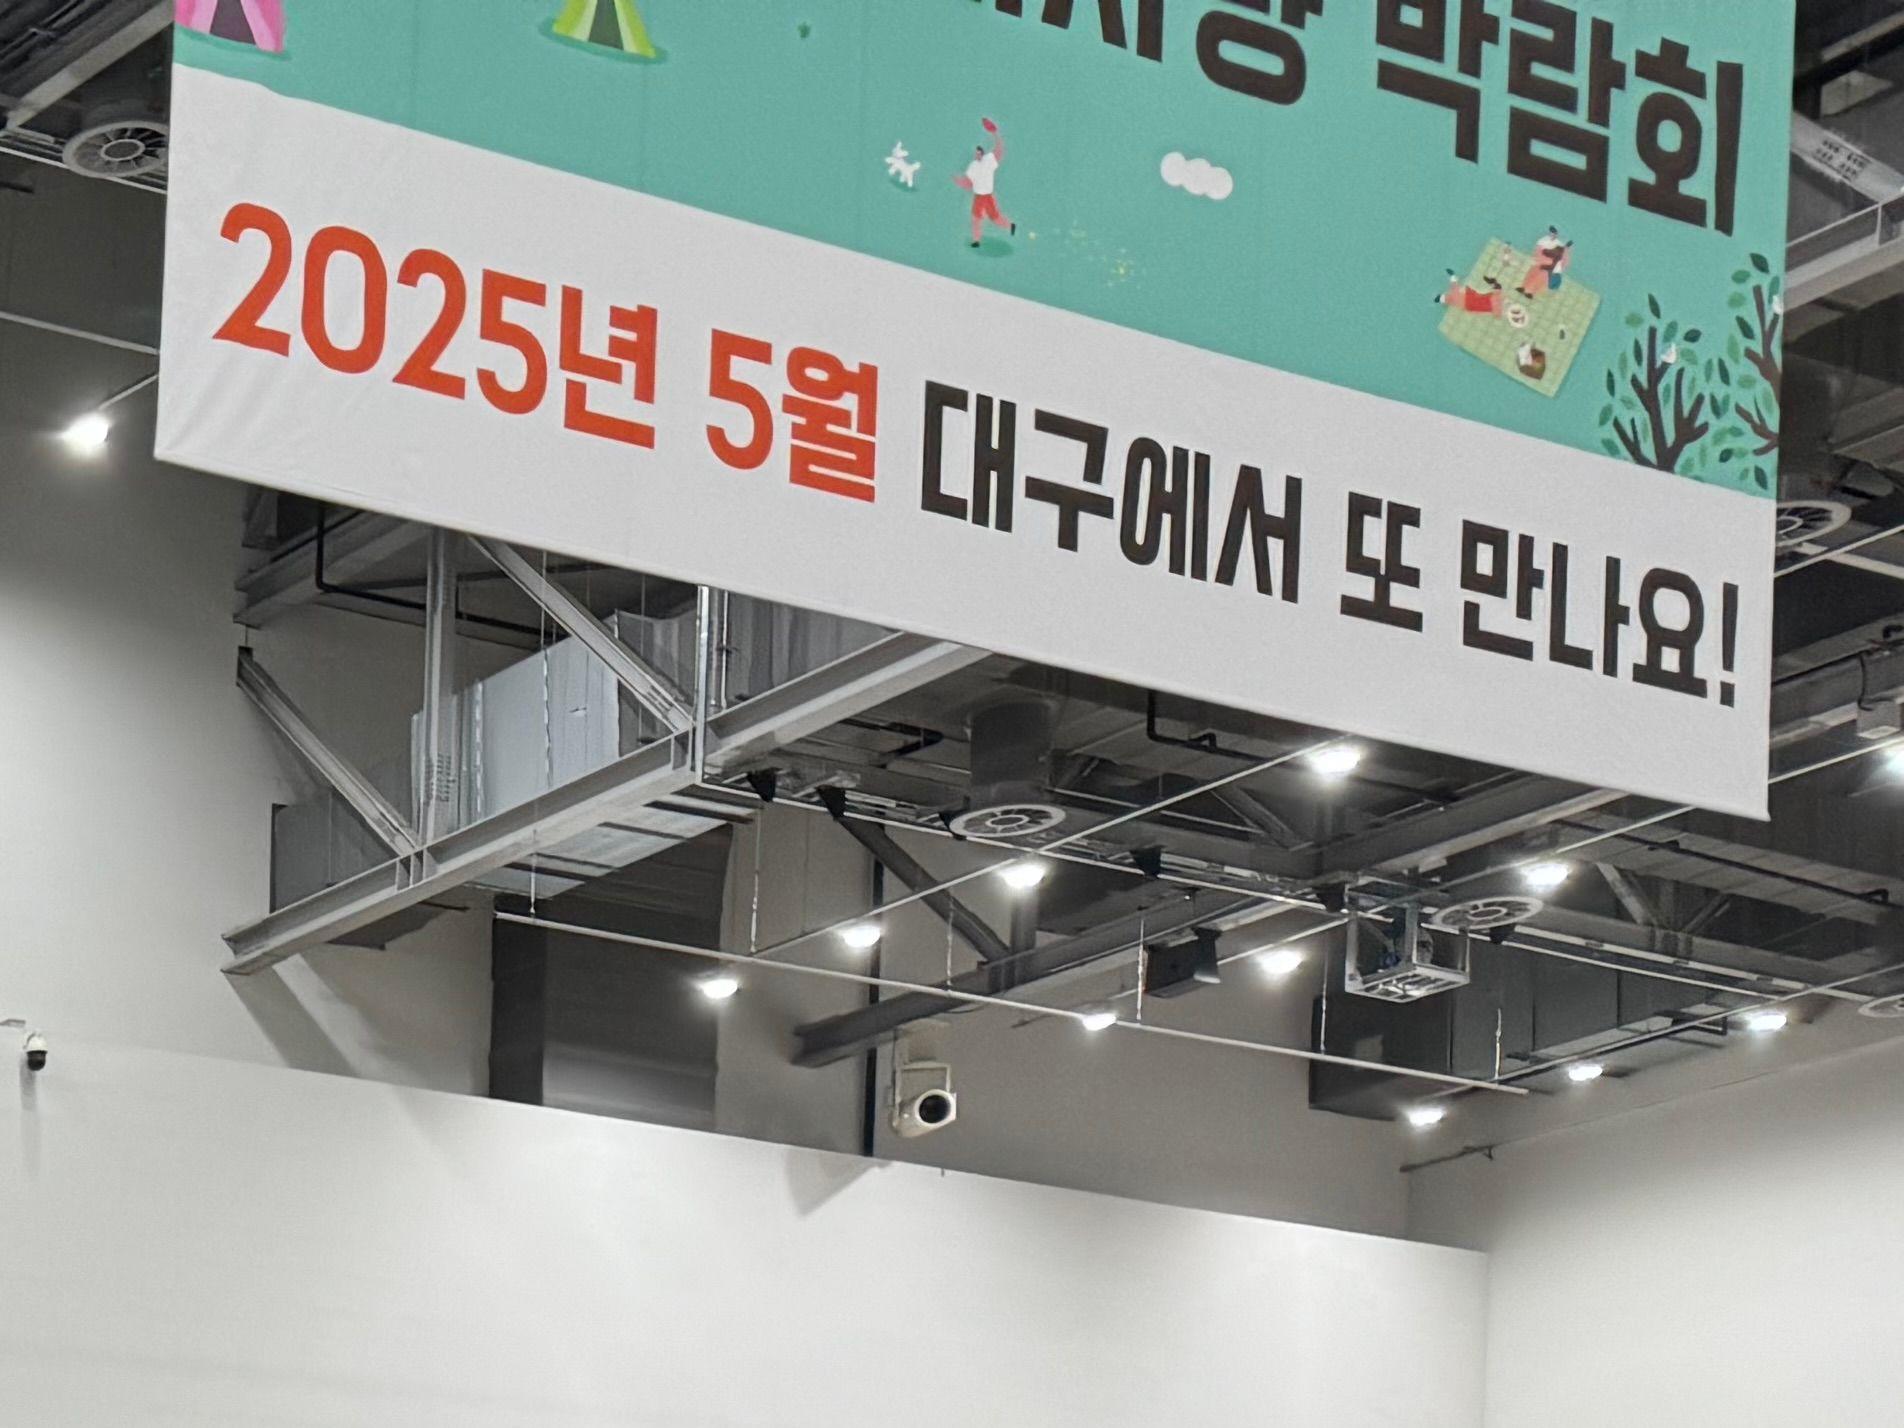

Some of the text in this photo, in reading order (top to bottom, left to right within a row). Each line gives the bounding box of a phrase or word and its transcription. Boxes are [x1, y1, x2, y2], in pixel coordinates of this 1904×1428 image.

[212, 201, 1740, 705] 2025년 5월 대구에서 또 만나요!
